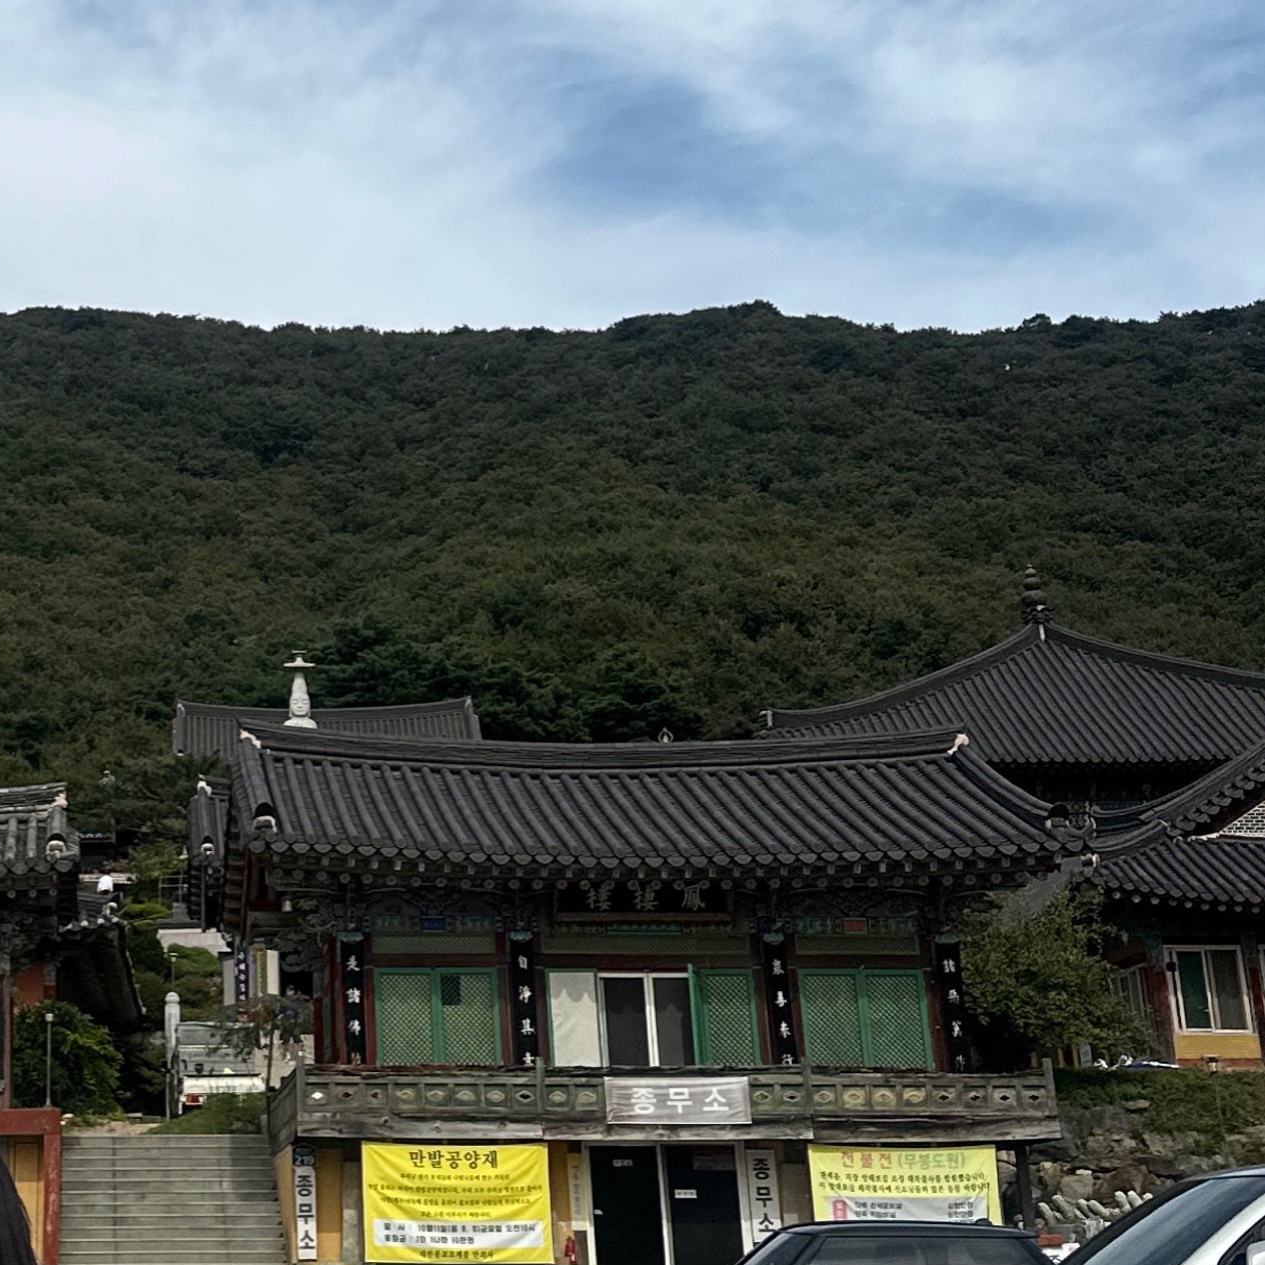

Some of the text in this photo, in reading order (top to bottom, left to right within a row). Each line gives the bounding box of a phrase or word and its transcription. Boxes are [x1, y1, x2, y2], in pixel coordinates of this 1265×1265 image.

[631, 1087, 730, 1115] 종무소
[295, 1155, 315, 1166] 219
[408, 1149, 499, 1170] 만발공양재
[752, 1158, 775, 1233] 종무소
[295, 1174, 316, 1250] 종무소
